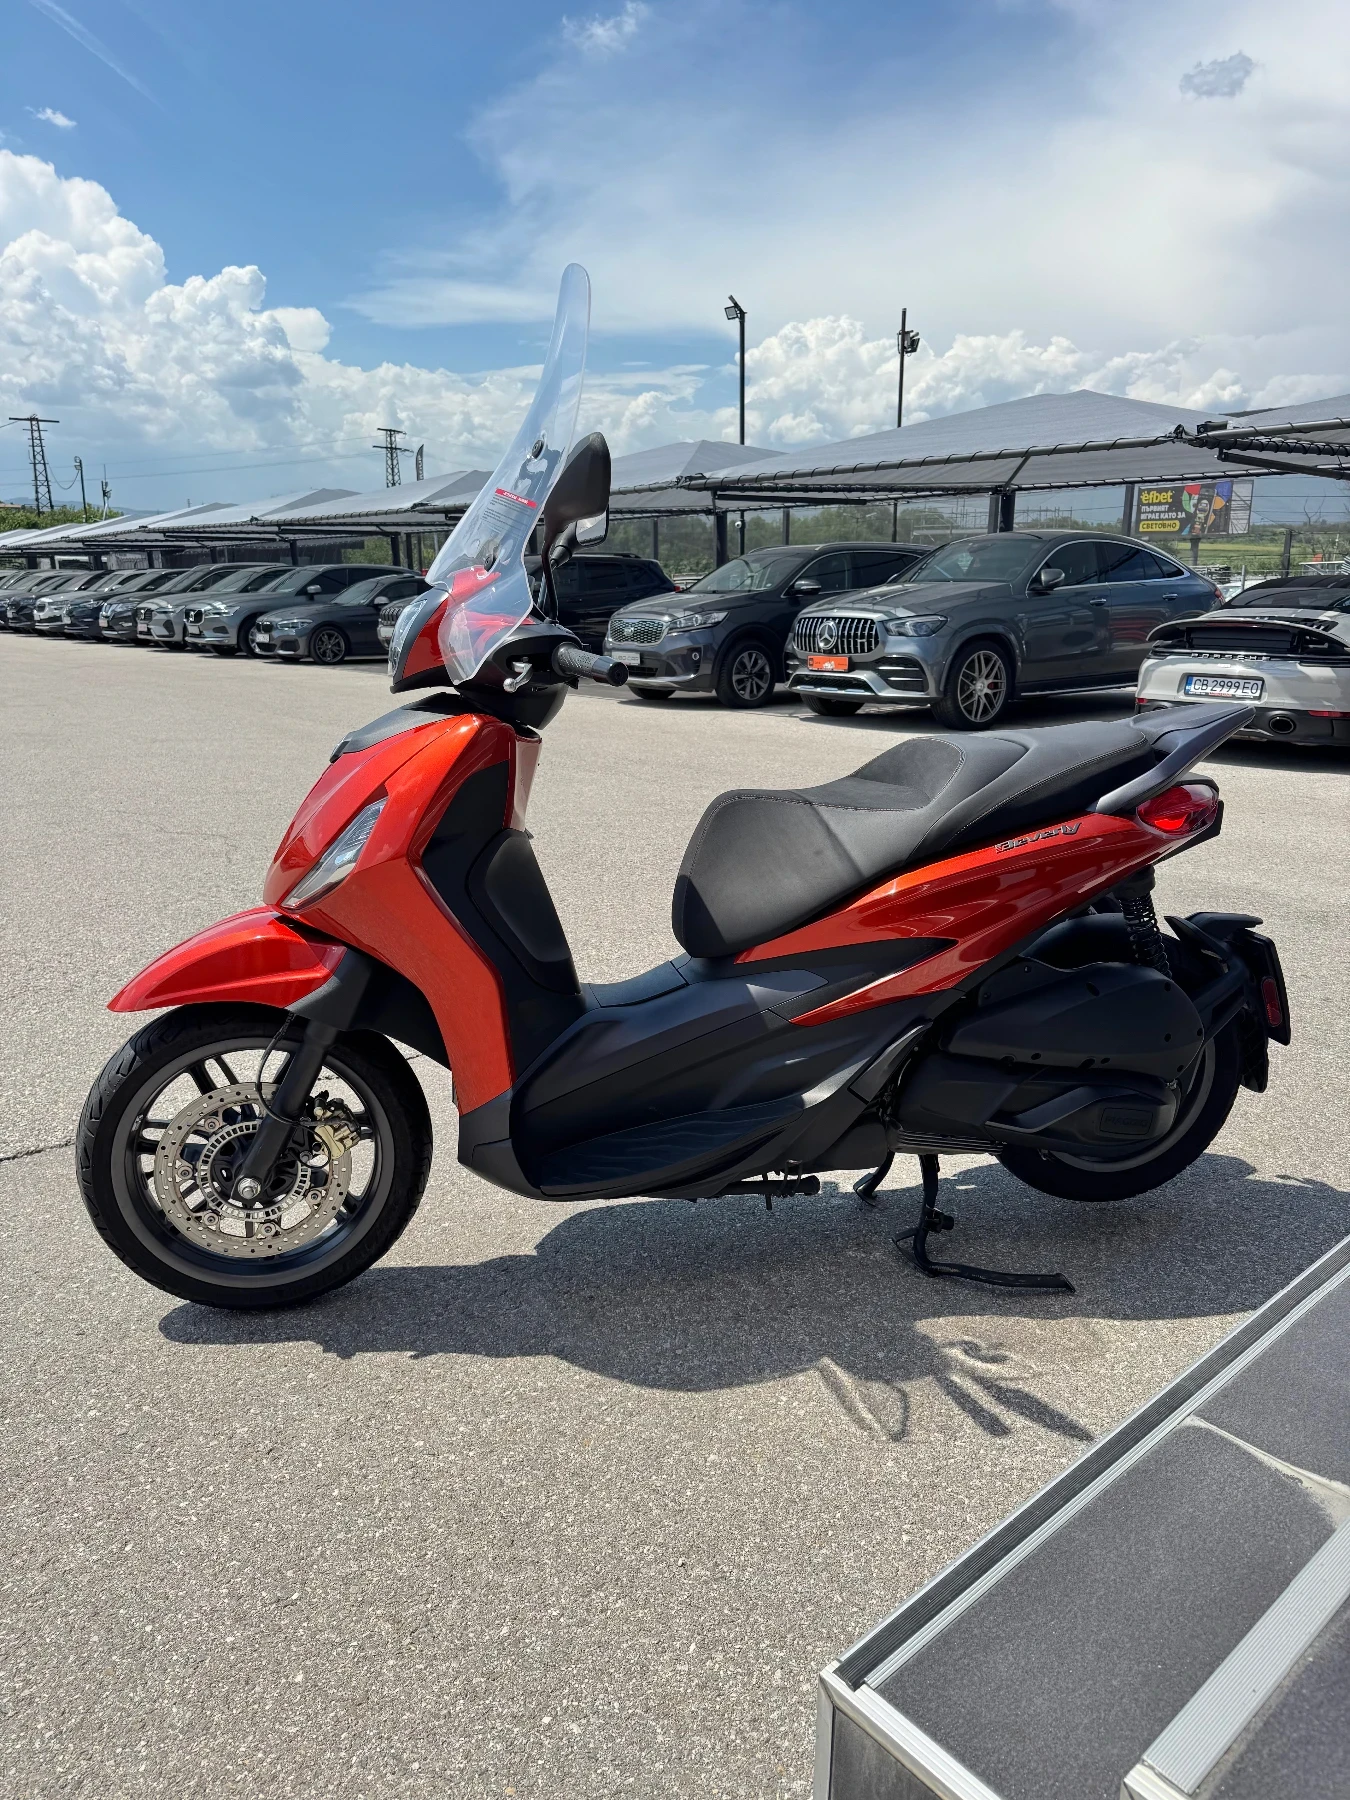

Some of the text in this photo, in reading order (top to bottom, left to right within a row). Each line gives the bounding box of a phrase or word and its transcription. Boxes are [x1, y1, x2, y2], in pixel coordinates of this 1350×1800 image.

[1142, 491, 1172, 503] efbet
[1177, 511, 1186, 519] ЗА
[1141, 522, 1177, 530] СВЕТОВНО
[1194, 679, 1208, 691] CB
[1210, 680, 1241, 693] 2999
[995, 822, 1082, 854] Beverly
